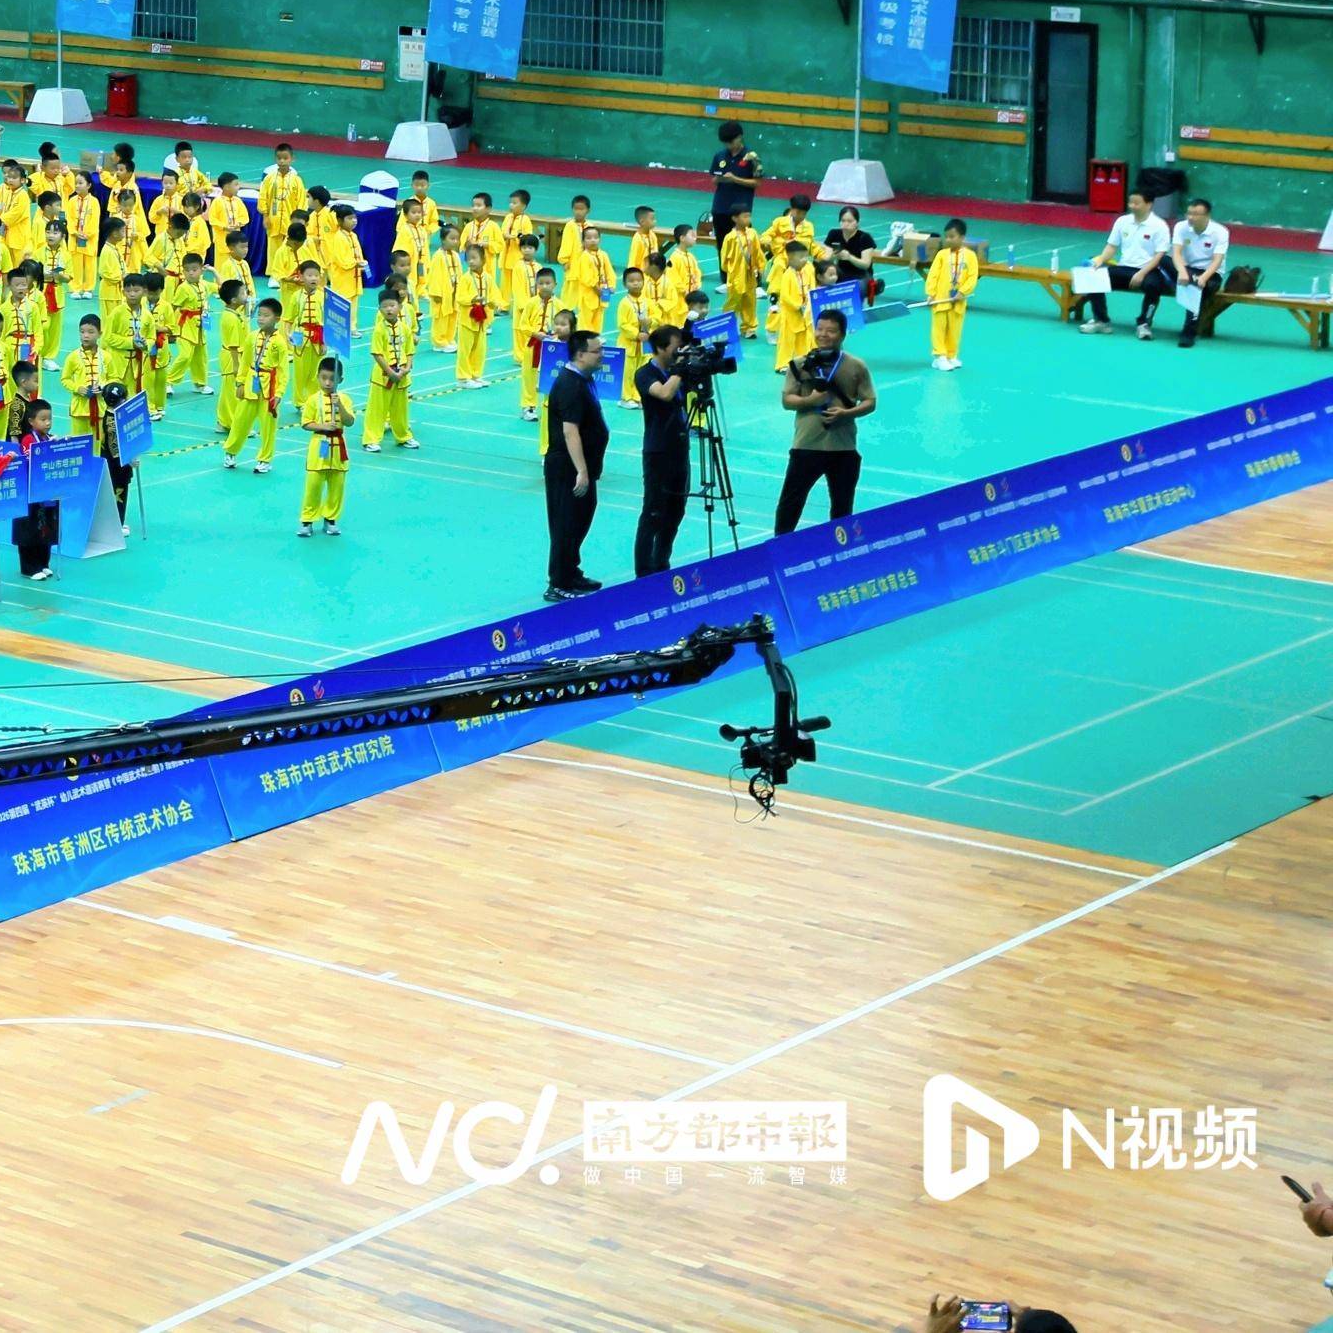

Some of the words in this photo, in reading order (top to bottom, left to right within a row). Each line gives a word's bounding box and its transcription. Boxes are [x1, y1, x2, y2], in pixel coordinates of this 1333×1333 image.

[259, 733, 396, 795] 珠海市中武武术研究院
[11, 798, 195, 877] 珠海市香洲区传统武术协会
